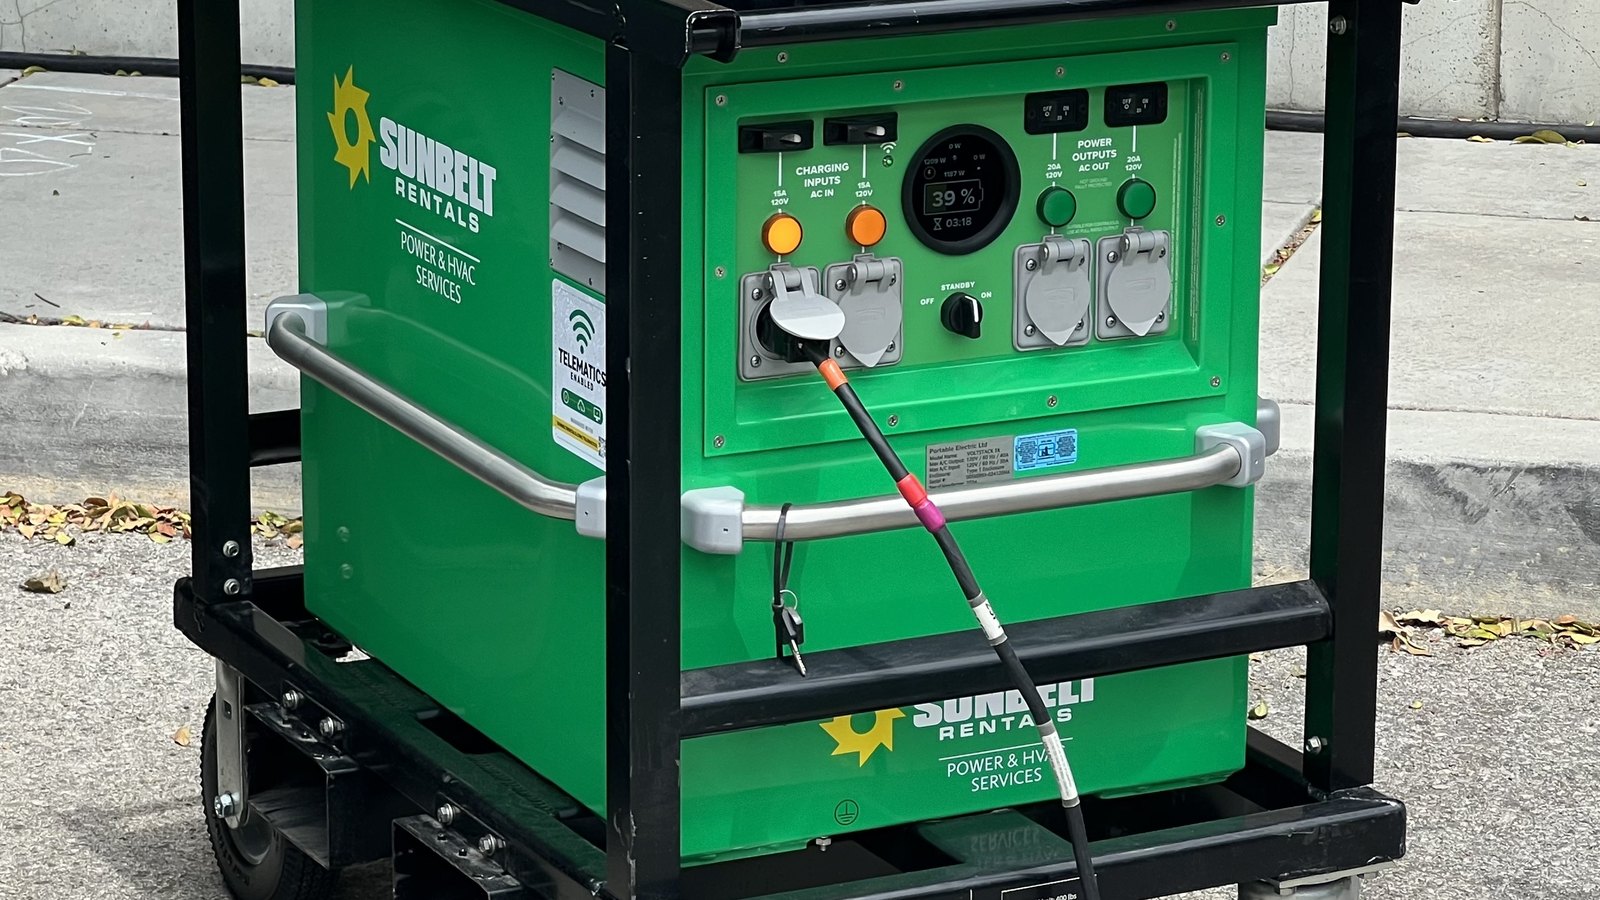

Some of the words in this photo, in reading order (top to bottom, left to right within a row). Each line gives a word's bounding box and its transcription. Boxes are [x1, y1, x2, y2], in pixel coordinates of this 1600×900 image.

[1077, 137, 1112, 149] POWER
[1071, 150, 1117, 162] OUTPUTS
[379, 116, 497, 217] SUNBELT
[795, 162, 849, 177] CHARGING
[1078, 164, 1091, 172] AC
[1092, 162, 1110, 171] OUT
[1125, 163, 1142, 171] 120V
[1045, 171, 1063, 179] 120V
[803, 176, 841, 188] INPUTS
[856, 181, 871, 190] 15A
[773, 190, 787, 198] 15A
[810, 189, 822, 199] AC
[824, 188, 834, 198] IN
[855, 189, 873, 198] 120V
[932, 190, 956, 207] 39
[960, 188, 975, 205] %
[395, 177, 480, 234] RENTALS
[770, 197, 789, 207] 120V
[945, 216, 972, 228] 03:18
[400, 231, 436, 264] POWER
[438, 254, 446, 272] &
[447, 256, 476, 286] HVAC
[416, 267, 462, 305] SERVICES
[940, 281, 976, 292] STANDBY
[981, 290, 993, 299] ON
[920, 297, 934, 307] OFF
[558, 347, 607, 388] TELEMATICS
[570, 372, 594, 392] ENABLED
[929, 446, 954, 454] Portable
[955, 443, 977, 451] Electric
[939, 707, 1073, 741] RENTAS
[947, 757, 1003, 777] POWER
[1008, 755, 1018, 767] &
[971, 767, 1042, 792] SERVICES
